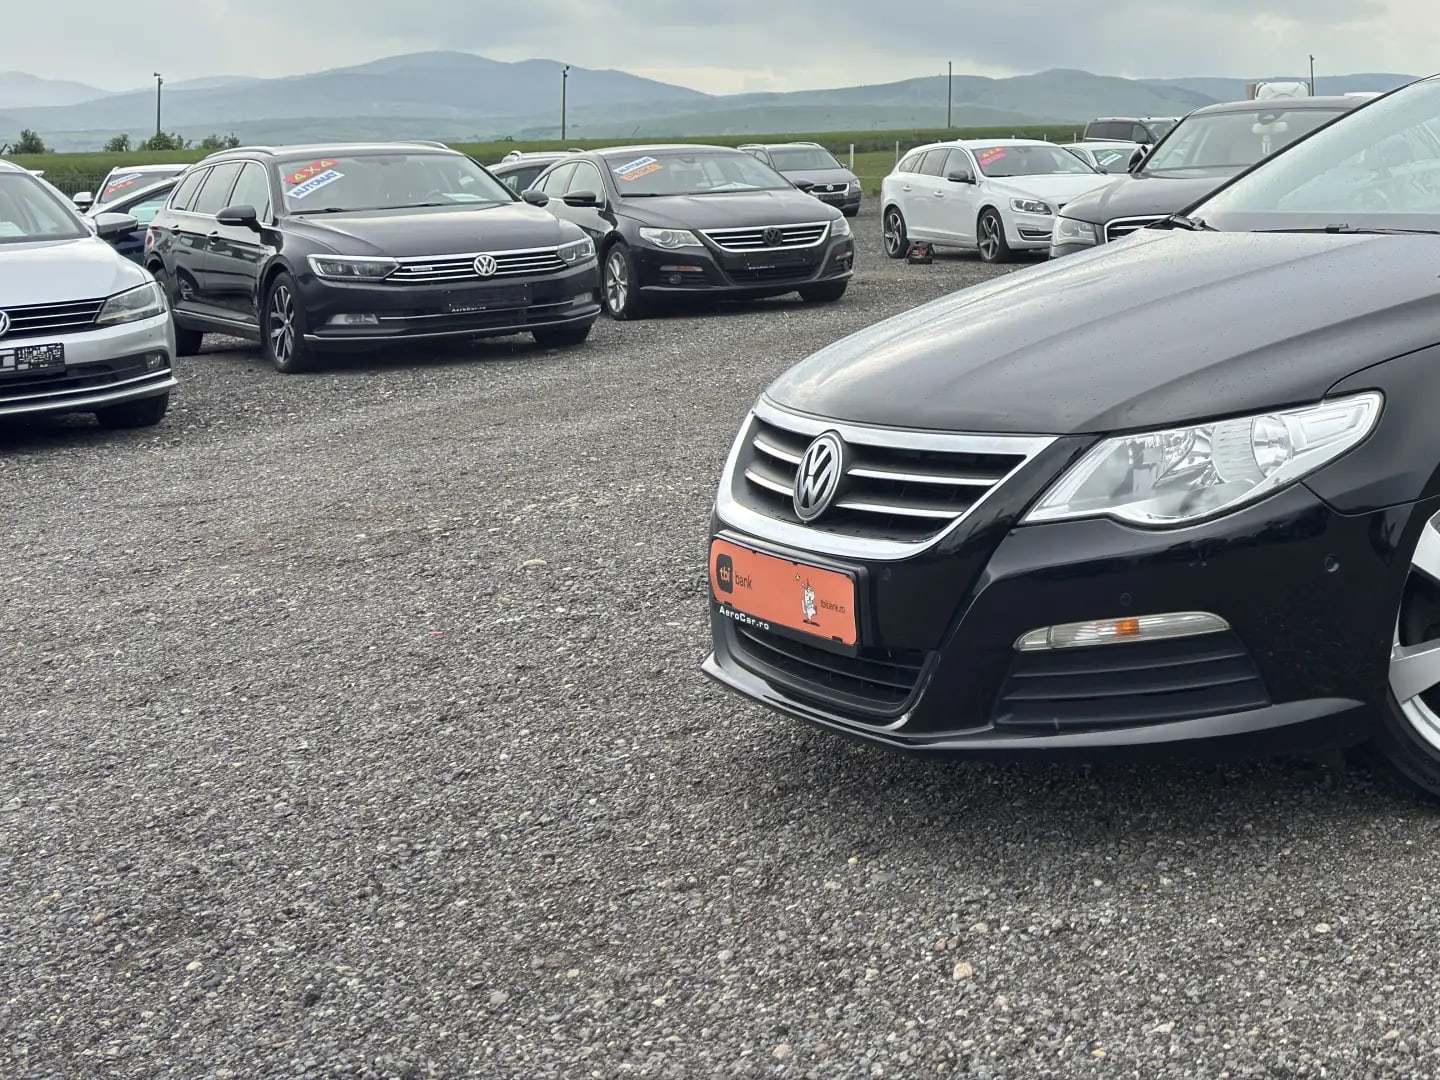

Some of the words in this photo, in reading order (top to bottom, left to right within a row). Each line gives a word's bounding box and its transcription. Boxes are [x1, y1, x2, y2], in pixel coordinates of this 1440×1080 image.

[292, 171, 338, 197] AUTOMAT
[719, 565, 731, 583] tbi
[735, 569, 753, 590] bank
[719, 604, 770, 631] AeroCar.ro
